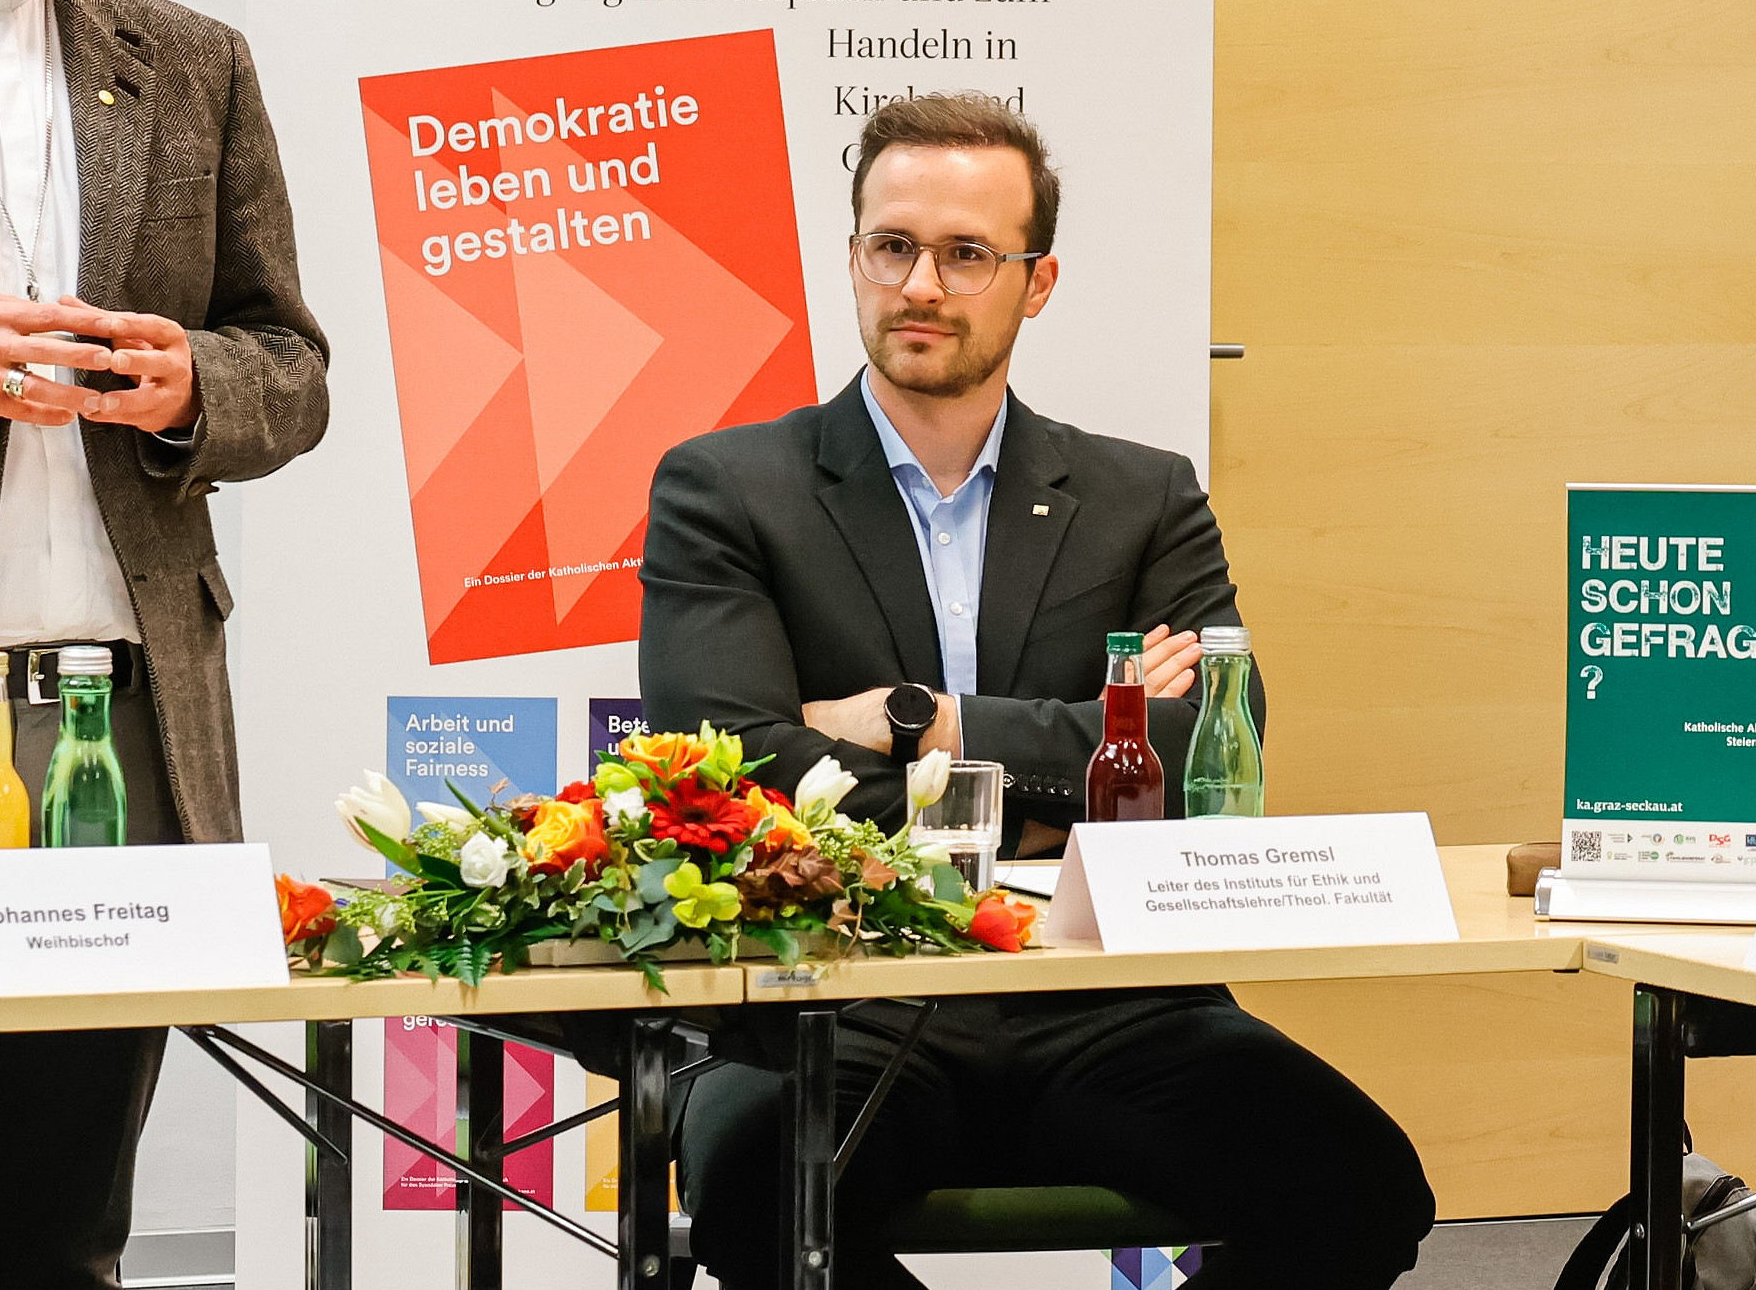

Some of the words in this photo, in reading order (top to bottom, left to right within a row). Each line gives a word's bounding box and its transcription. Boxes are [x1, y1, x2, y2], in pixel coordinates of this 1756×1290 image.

[827, 28, 972, 59] Handeln
[985, 30, 1017, 59] in
[408, 85, 699, 157] Demokratie
[414, 164, 552, 211] leben
[567, 142, 660, 193] und
[421, 208, 651, 276] gestalten
[1581, 535, 1725, 572] HEUTE
[464, 577, 482, 588] Ein
[484, 571, 525, 586] Dossier
[527, 568, 546, 580] der
[548, 560, 619, 577] Katholischen
[1581, 579, 1732, 615] SCHON
[1580, 665, 1604, 699] ?
[405, 714, 470, 733] Arbeit
[476, 715, 514, 733] und
[1684, 721, 1744, 734] Katholische
[405, 736, 475, 755] soziale
[405, 758, 489, 778] Fairness
[1576, 798, 1683, 813] ka.graz-seckau.at
[1180, 850, 1259, 867] Thomas
[1265, 846, 1335, 863] Gremsl
[1147, 878, 1189, 893] Leiter
[1194, 877, 1220, 891] des
[1224, 875, 1284, 890] Instituts
[1287, 875, 1308, 888] für
[1311, 873, 1349, 887] Ethik
[1353, 872, 1381, 885] und
[1145, 893, 1330, 912] Gesellschaftslehre/Theol.
[1334, 890, 1393, 905] Fakultät
[93, 902, 170, 923] Freitag
[26, 932, 131, 949] Weihbischof
